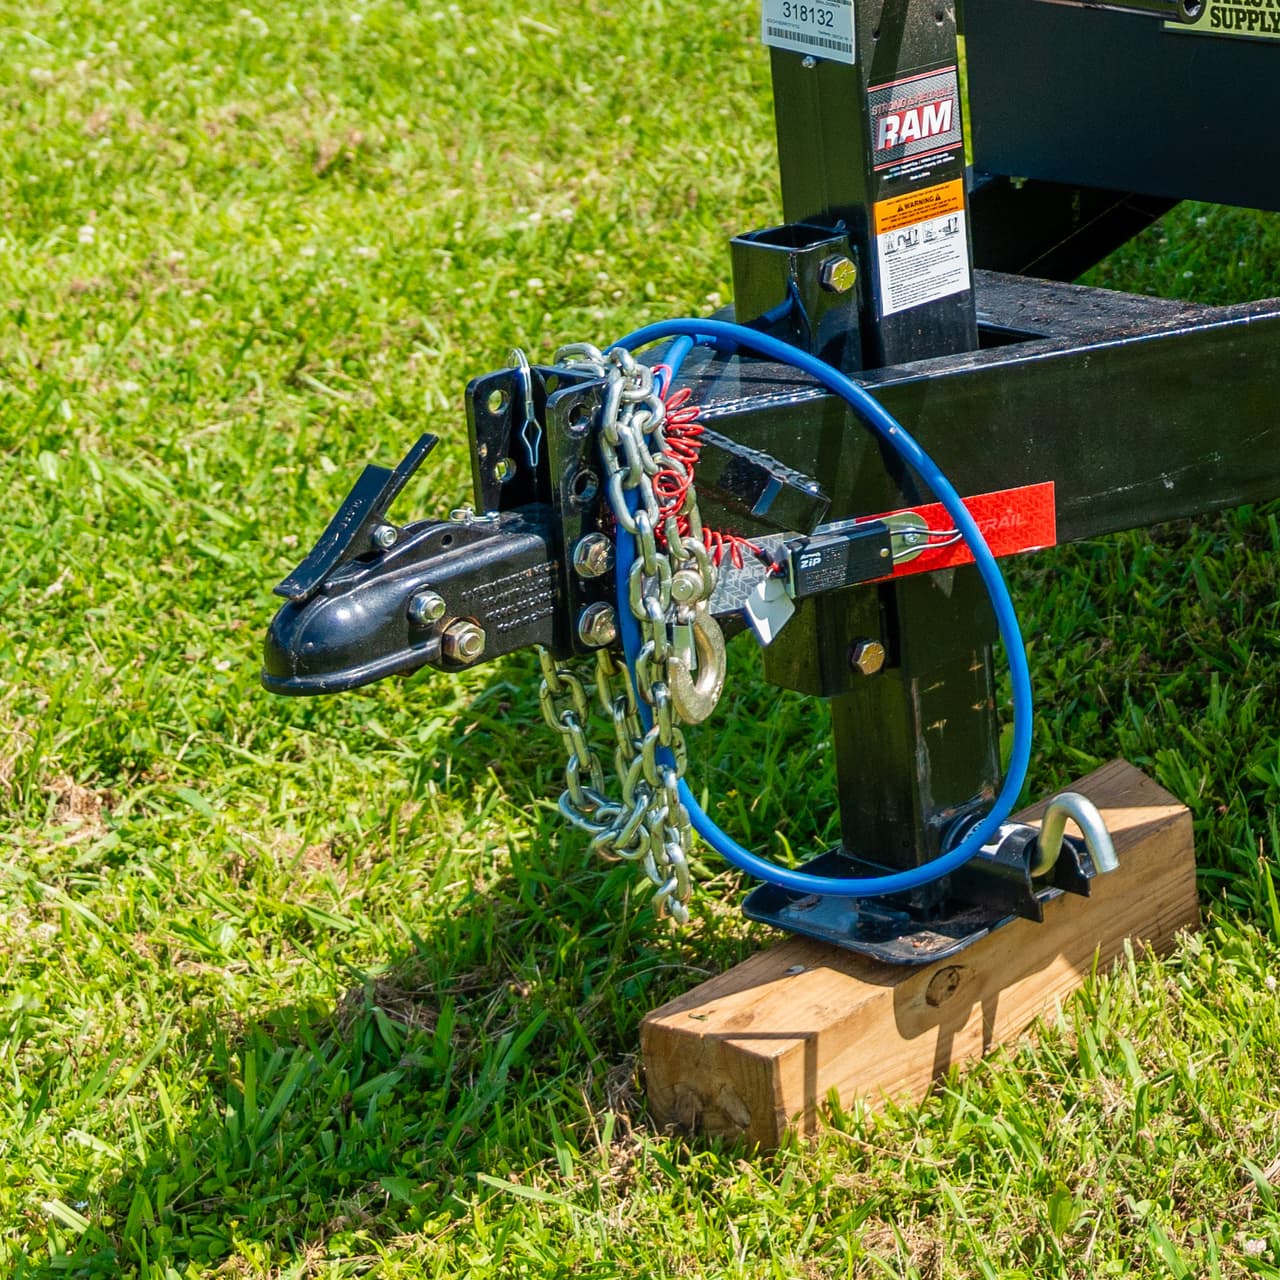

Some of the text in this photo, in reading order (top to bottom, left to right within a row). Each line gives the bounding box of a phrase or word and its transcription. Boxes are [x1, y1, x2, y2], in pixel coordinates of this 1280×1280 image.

[783, 1, 834, 28] 318132
[877, 99, 954, 150] RAM
[904, 195, 935, 210] WARNING
[976, 513, 1028, 534] TRAIL
